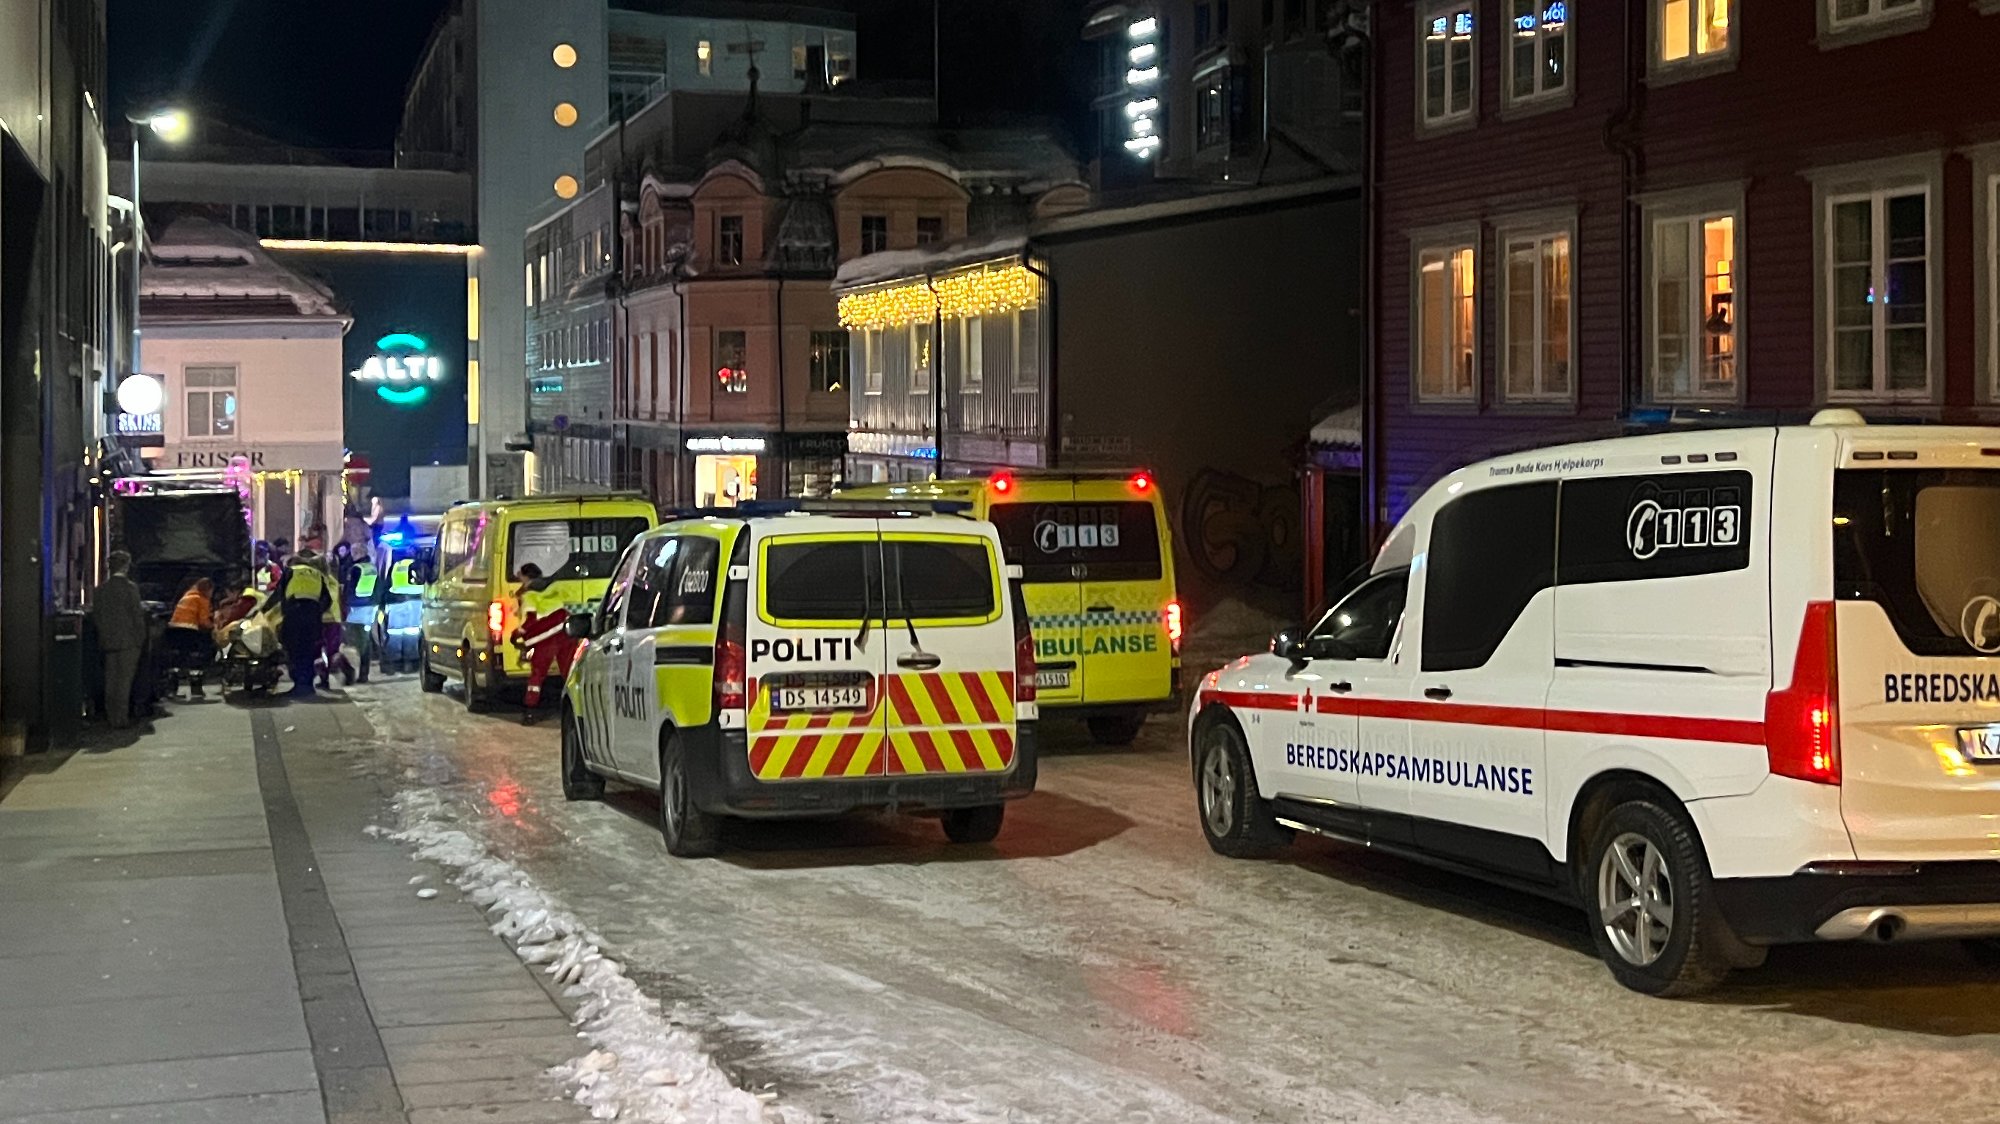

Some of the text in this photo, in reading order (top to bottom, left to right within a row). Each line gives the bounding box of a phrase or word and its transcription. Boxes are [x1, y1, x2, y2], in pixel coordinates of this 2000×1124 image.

[351, 356, 439, 380] ALTI
[119, 412, 161, 427] SKINS
[1535, 461, 1552, 472] Kors
[1554, 458, 1604, 472] Hjelpekorps
[1058, 526, 1118, 546] 113
[1660, 508, 1738, 545] 113
[569, 536, 616, 553] 113
[751, 637, 852, 662] POLITI
[1035, 634, 1157, 657] BULANSE
[614, 685, 647, 721] POLITI
[785, 689, 861, 706] DS 14549
[1286, 743, 1533, 795] BEREDSKAPSAMBULANSE
